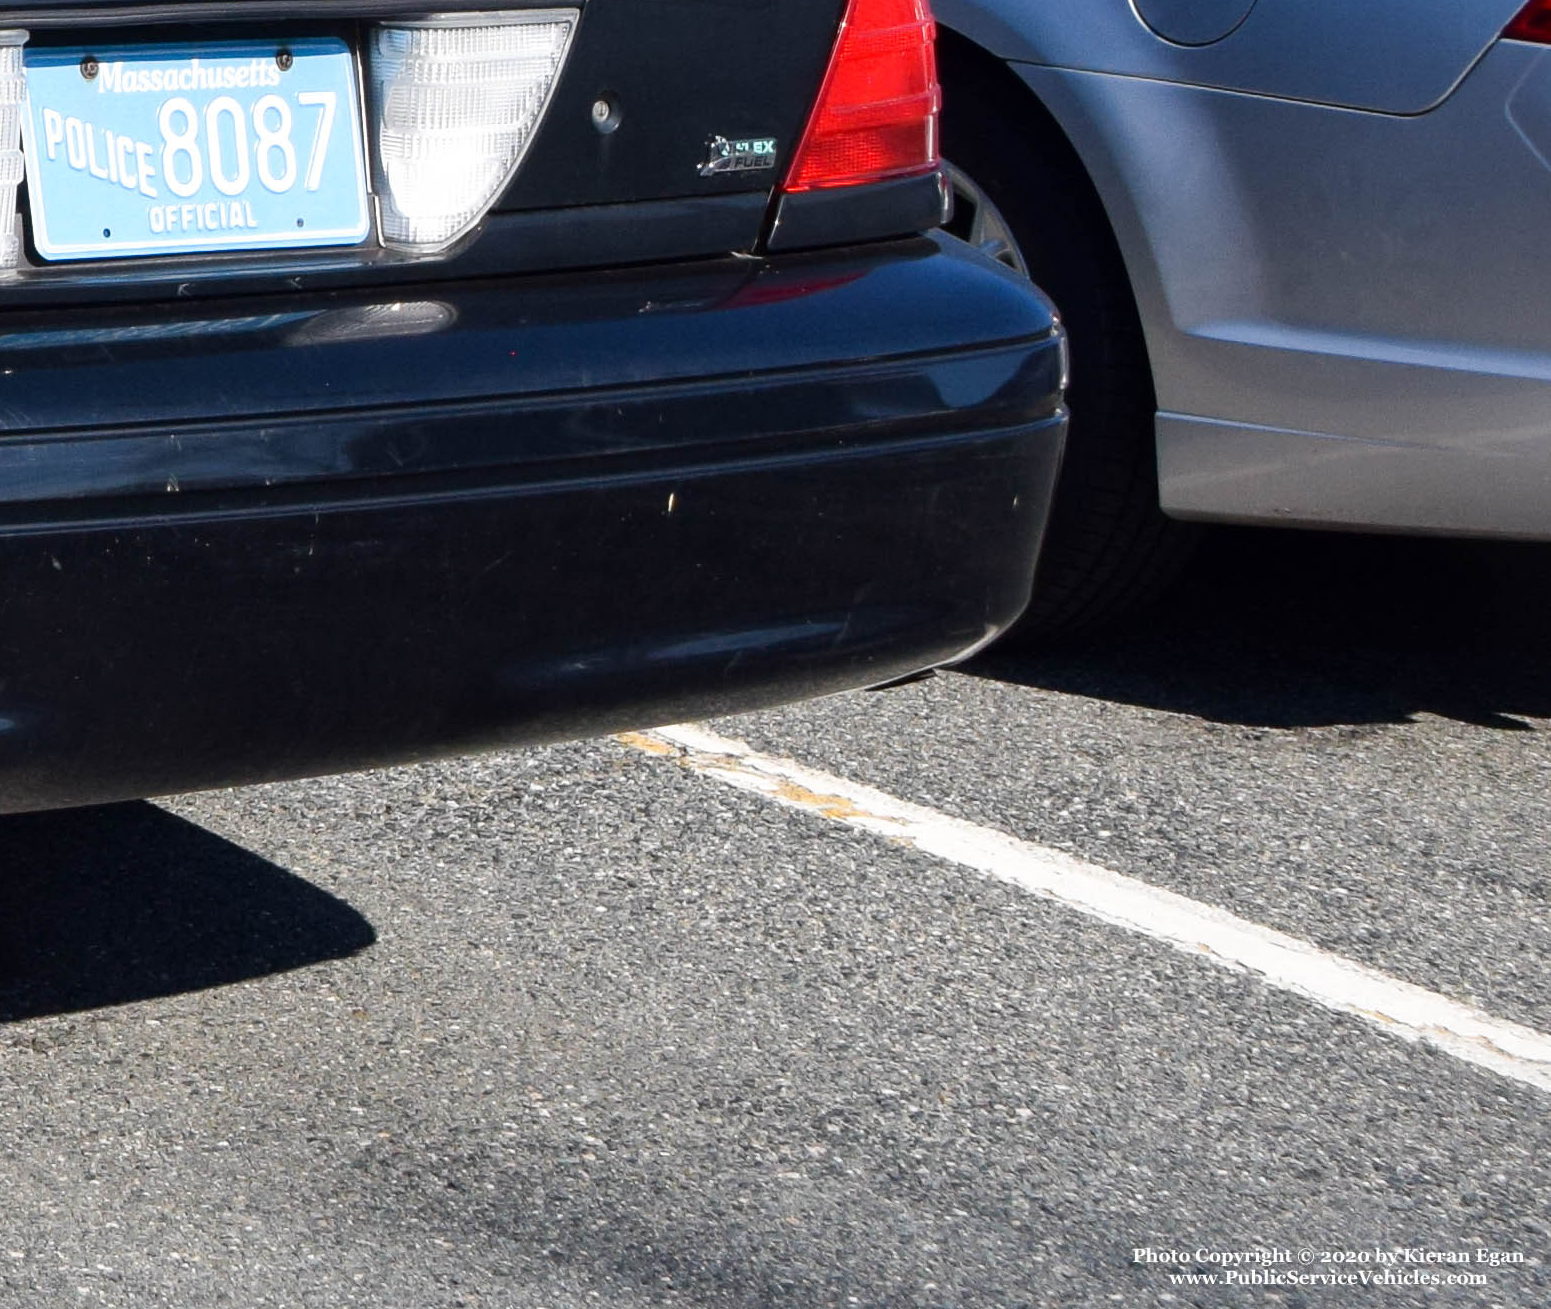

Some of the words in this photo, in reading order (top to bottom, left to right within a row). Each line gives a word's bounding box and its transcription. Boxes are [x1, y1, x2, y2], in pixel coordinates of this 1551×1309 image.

[98, 58, 281, 93] Massachusetts
[42, 107, 158, 198] POLICE
[156, 91, 338, 197] 8087
[149, 201, 259, 233] OFFICIAL
